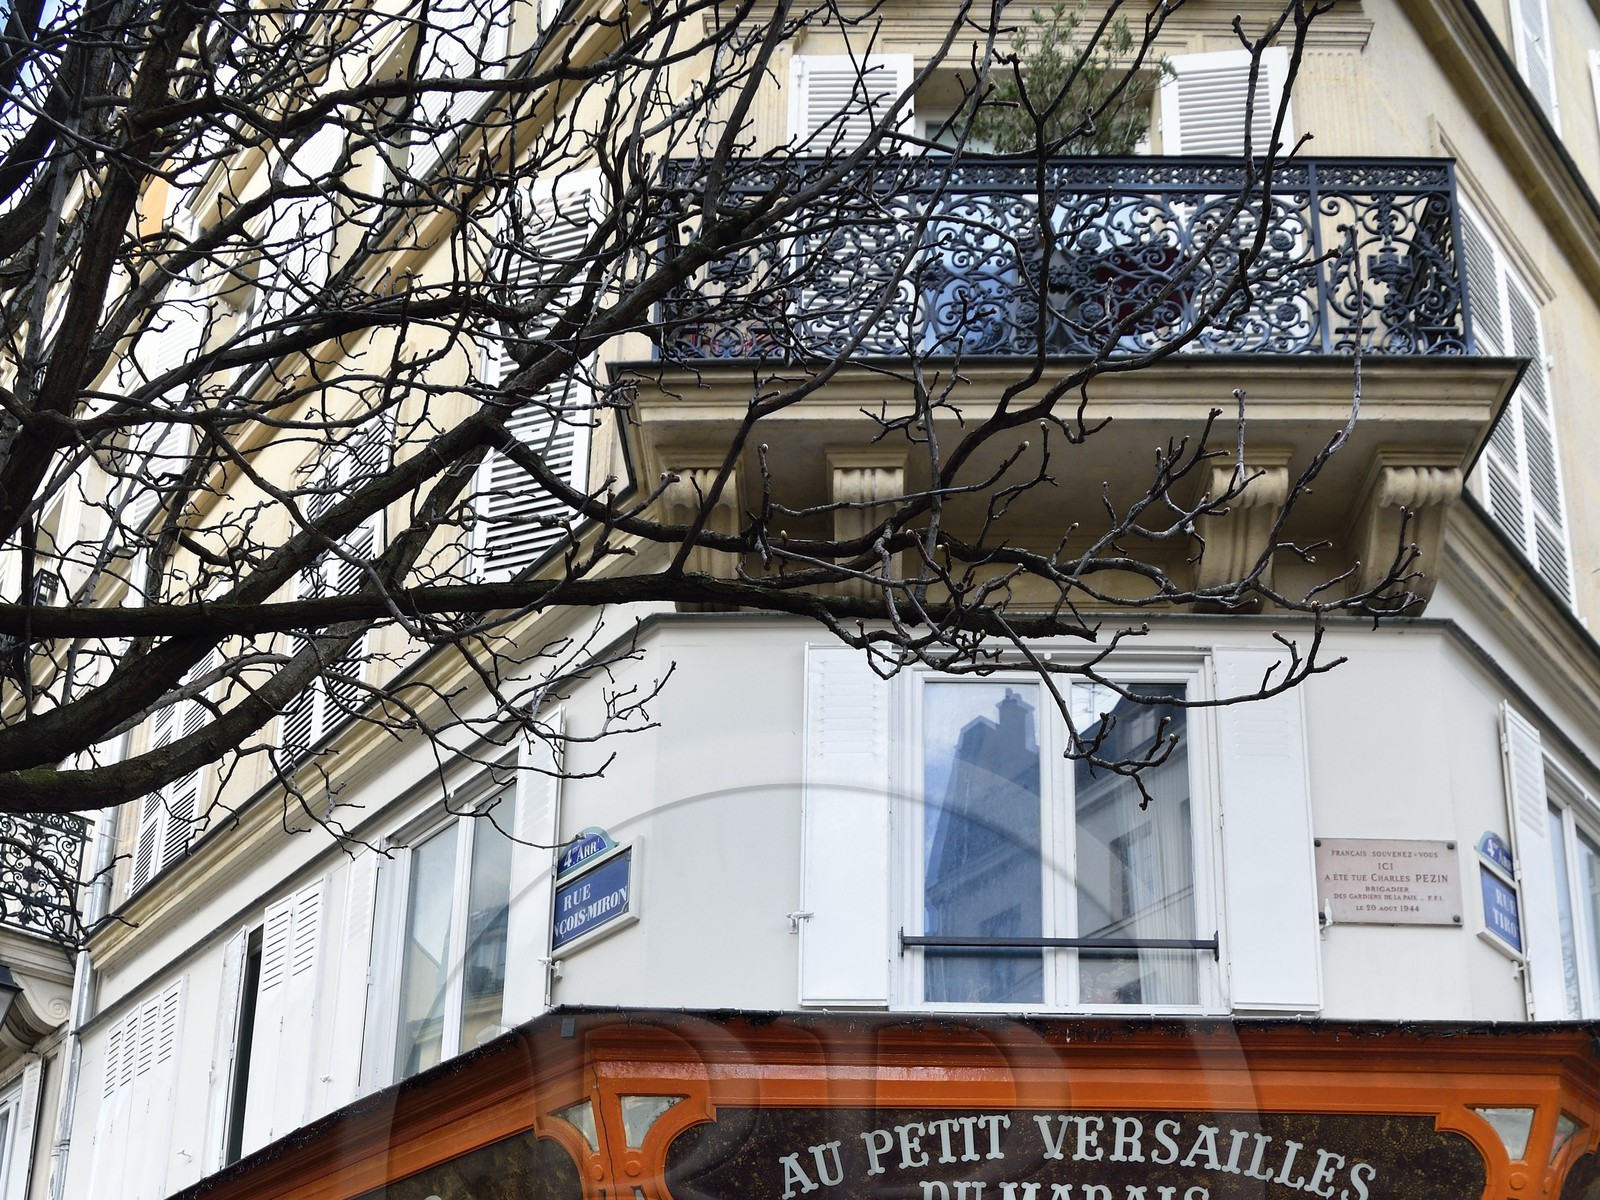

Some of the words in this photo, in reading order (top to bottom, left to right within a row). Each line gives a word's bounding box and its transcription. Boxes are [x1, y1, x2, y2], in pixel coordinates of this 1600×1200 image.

[1377, 862, 1394, 871] ICI
[1415, 874, 1449, 884] PEZIN
[1365, 885, 1410, 893] BRIGADIER
[563, 883, 591, 912] RUE
[778, 1140, 844, 1200] AU
[859, 1114, 1011, 1176] PETIT
